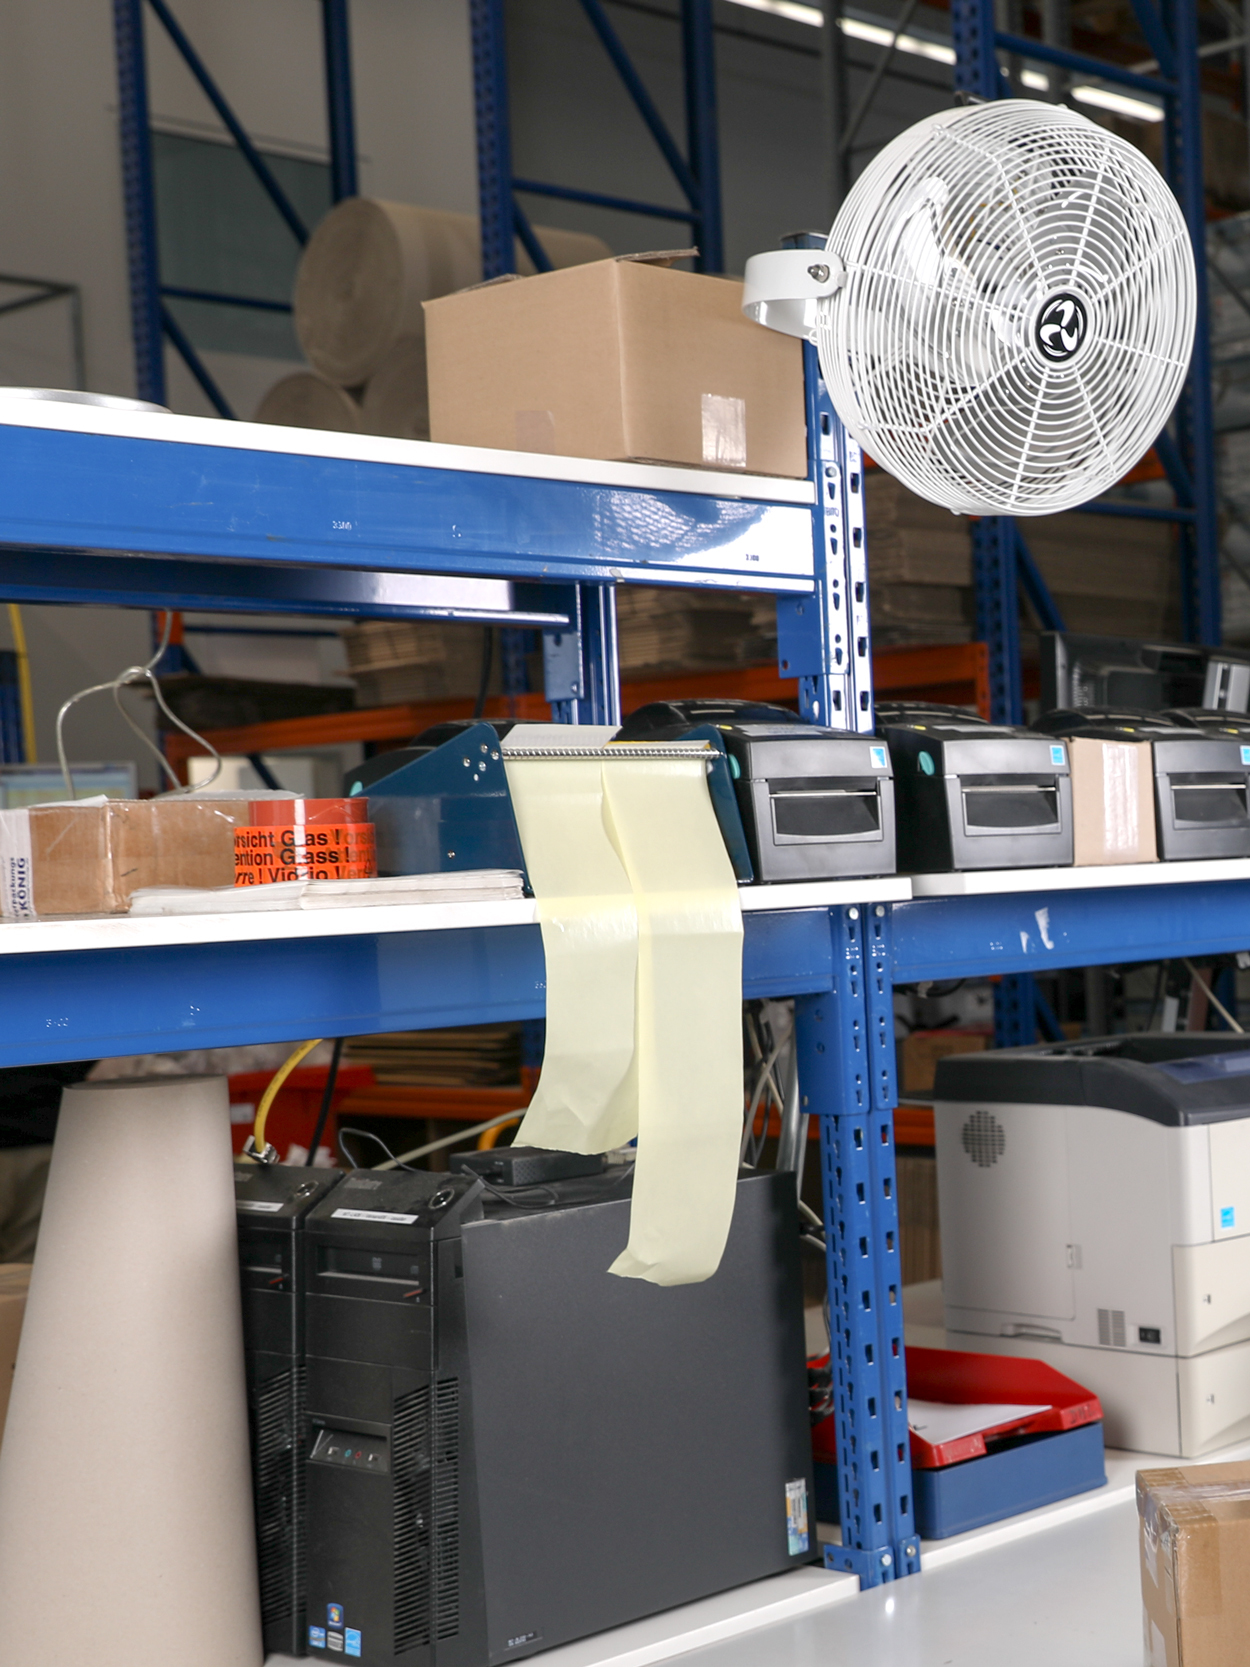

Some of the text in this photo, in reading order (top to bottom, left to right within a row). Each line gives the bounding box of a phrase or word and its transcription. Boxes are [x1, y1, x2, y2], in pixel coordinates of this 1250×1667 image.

[281, 830, 328, 847] Gas
[280, 848, 339, 865] Gass
[17, 858, 27, 910] KÖNIG
[234, 871, 255, 885] rre
